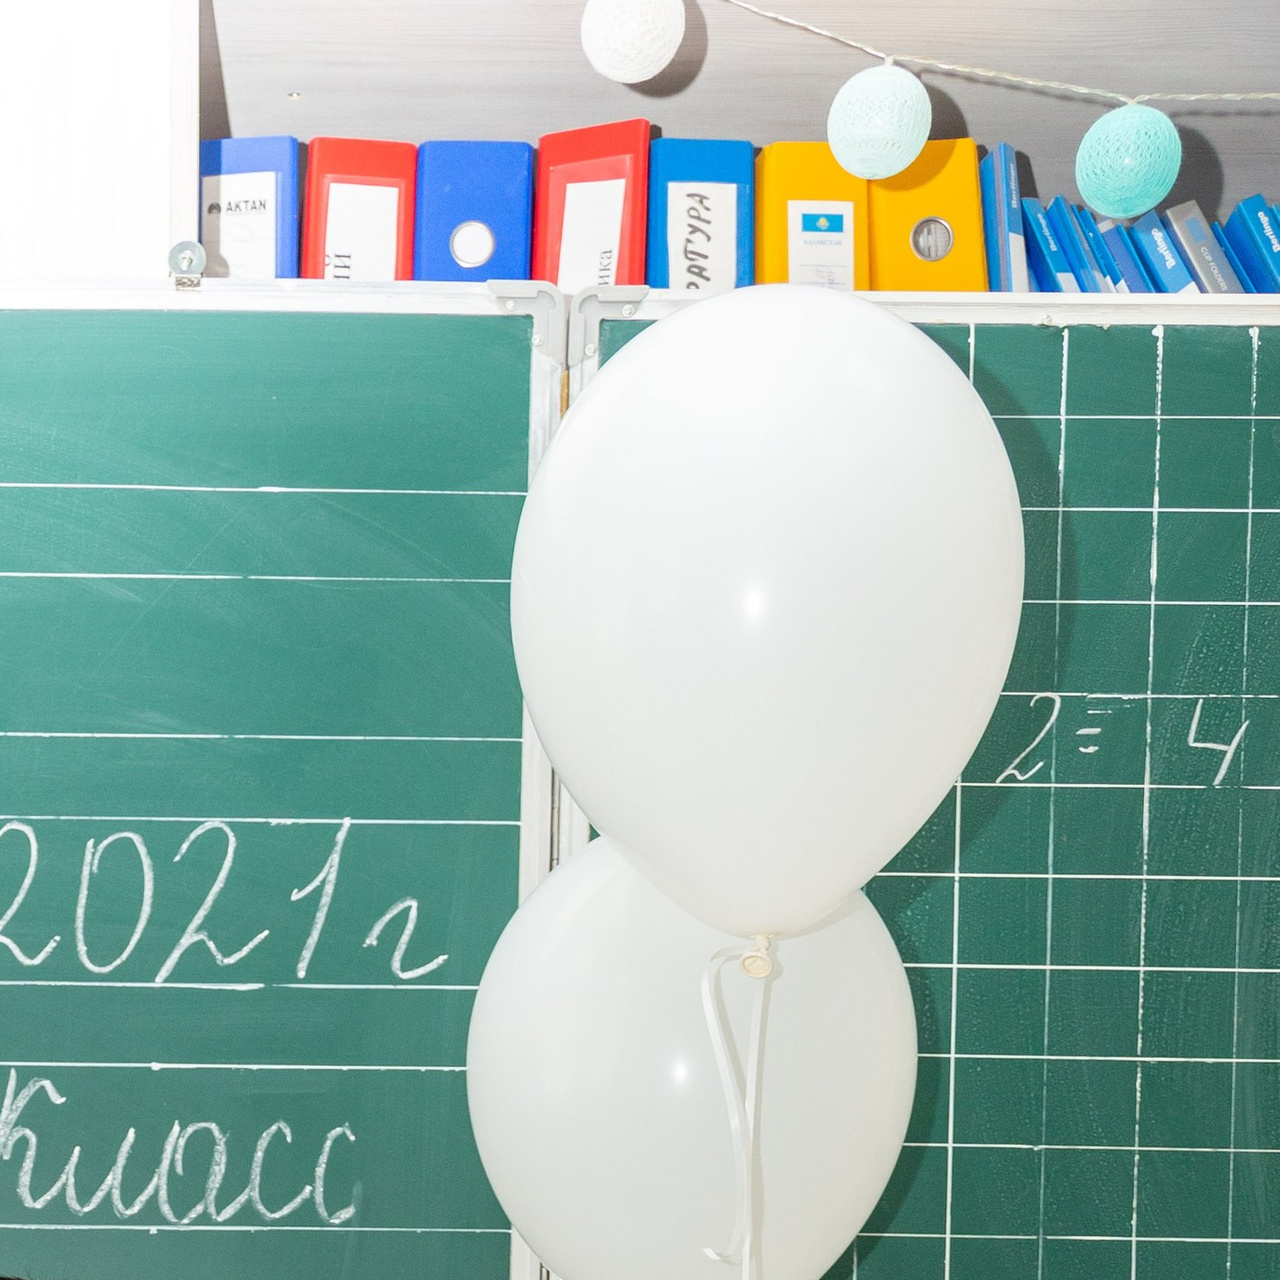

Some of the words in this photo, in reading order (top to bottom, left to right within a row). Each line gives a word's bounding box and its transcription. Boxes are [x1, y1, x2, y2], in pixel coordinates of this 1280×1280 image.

[226, 199, 266, 212] AKTAN
[1150, 227, 1176, 270] Berlingo
[1186, 697, 1251, 786] 4
